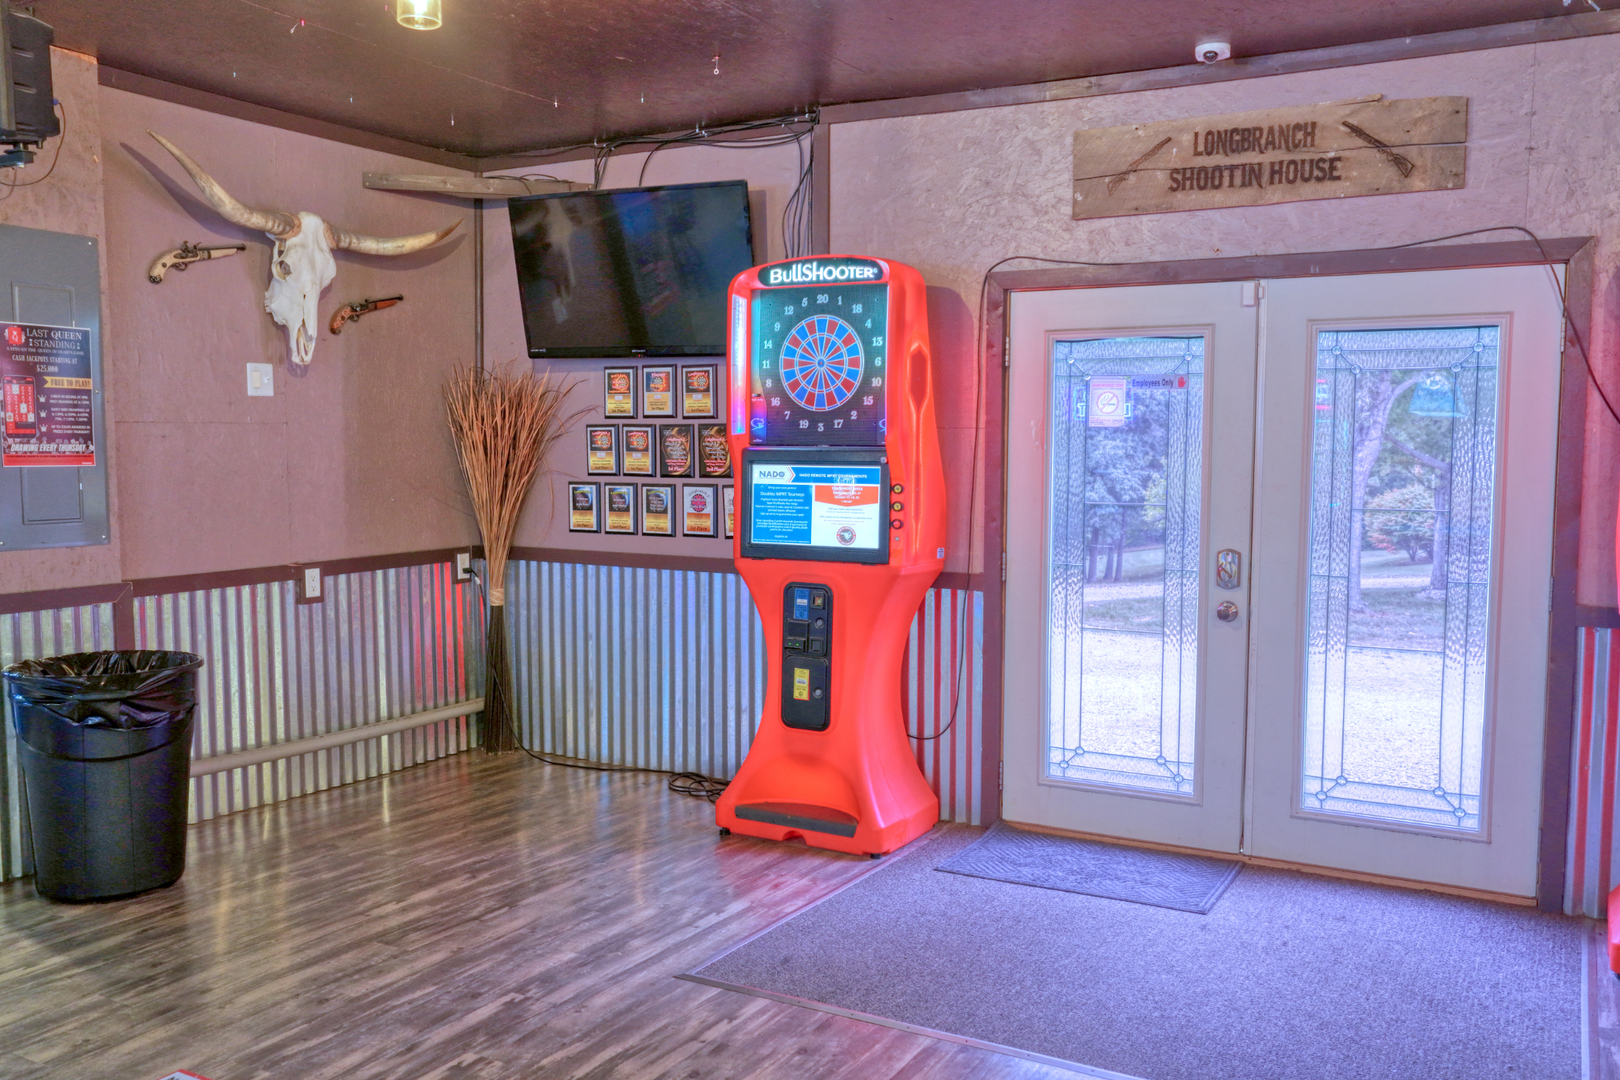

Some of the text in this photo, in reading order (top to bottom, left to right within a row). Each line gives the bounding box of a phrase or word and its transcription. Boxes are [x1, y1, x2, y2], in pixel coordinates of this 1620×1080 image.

[1193, 121, 1316, 156] LONGBRANCH
[1169, 156, 1342, 193] SHOOTIN HOUSE
[802, 298, 808, 306] 5
[817, 294, 828, 304] 20
[838, 296, 842, 304] 1
[784, 306, 794, 315] 12
[852, 304, 862, 313] 18
[774, 323, 780, 331] 9
[865, 319, 872, 328] 4
[26, 328, 82, 340] LAST QUEEN
[34, 340, 75, 349] STANDING
[764, 340, 772, 349] 14
[872, 337, 882, 346] 13
[763, 360, 770, 369] 11
[875, 357, 882, 366] 6
[51, 378, 91, 388] FREE TO PLAY!
[766, 379, 772, 387] 8
[872, 377, 882, 386] 10
[1132, 379, 1173, 389] Employees Only
[771, 397, 780, 406] 16
[863, 396, 873, 405] 15
[784, 411, 790, 420] 7
[851, 411, 857, 419] 2
[799, 420, 809, 429] 19
[818, 423, 824, 432] 3
[834, 420, 843, 428] 17
[11, 444, 86, 452] DRAWING EVERY THURSDAY
